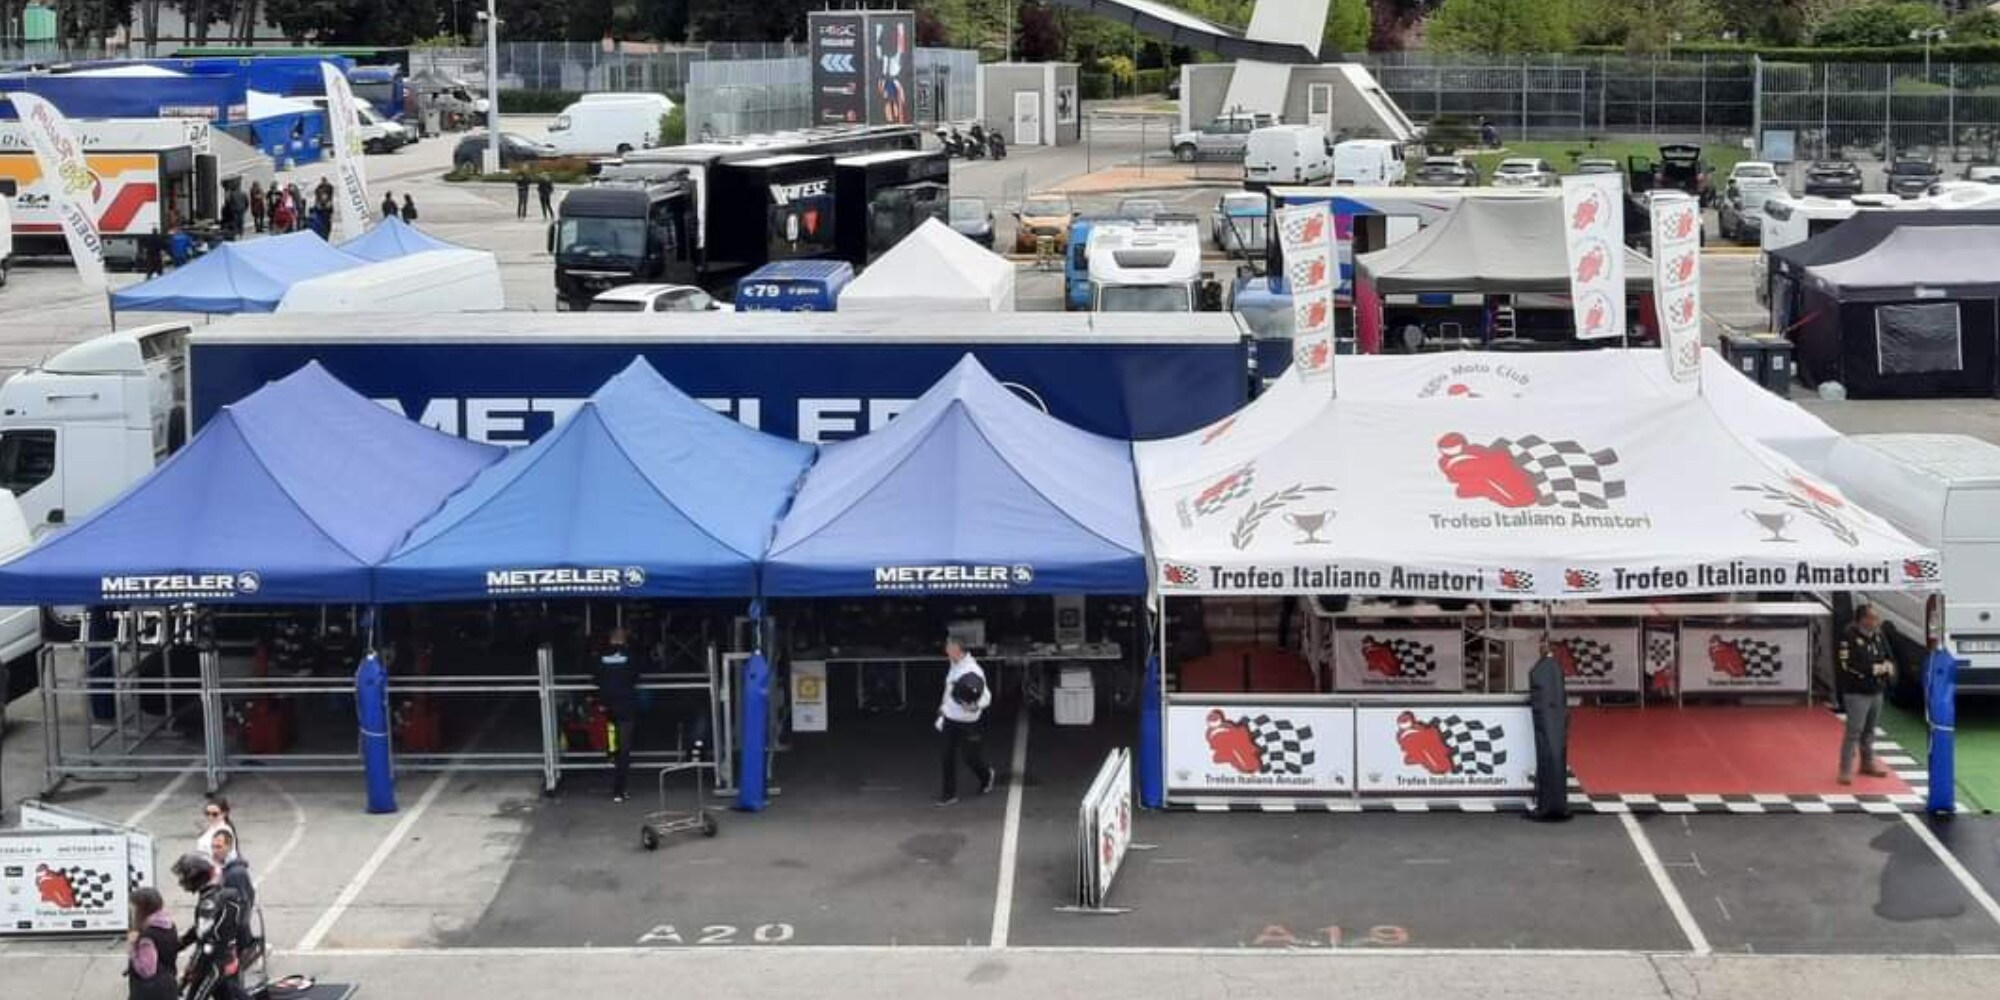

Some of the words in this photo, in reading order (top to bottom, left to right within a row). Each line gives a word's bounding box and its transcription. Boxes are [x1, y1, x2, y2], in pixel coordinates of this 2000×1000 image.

[1429, 513, 1490, 528] Trofeo
[1495, 510, 1565, 527] Italiano
[1571, 512, 1651, 528] Amatori
[486, 569, 620, 586] METZELER
[875, 566, 1007, 582] METZELER
[1210, 566, 1283, 590] Trofeo
[1293, 564, 1381, 590] Italiano
[1390, 566, 1484, 592] Amatori
[1613, 566, 1688, 590] Trofeo
[1698, 561, 1786, 587] Italiano
[1795, 561, 1889, 587] Amatori
[101, 575, 234, 591] METZELER
[1204, 774, 1235, 786] Trofeo
[1238, 774, 1273, 786] Italiano
[1276, 774, 1315, 786] Amatori
[1397, 775, 1427, 786] Trofeo
[1430, 775, 1466, 786] Italiano
[1469, 775, 1507, 786] Amatori
[636, 922, 796, 944] A20
[1254, 923, 1410, 945] A19
